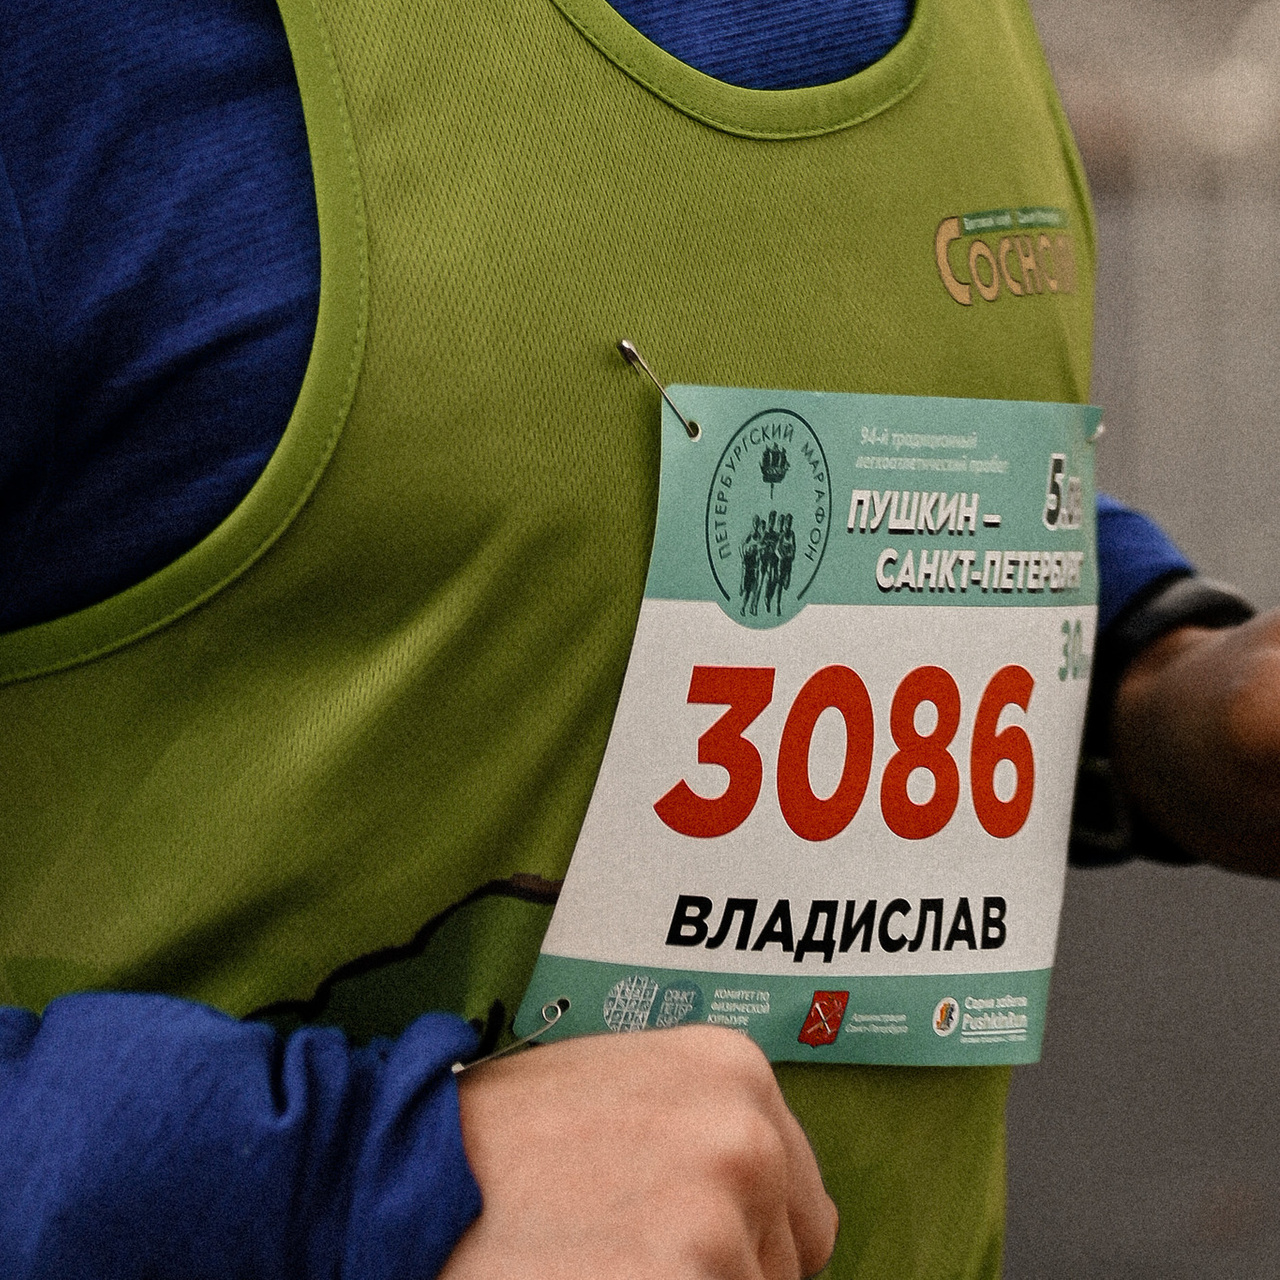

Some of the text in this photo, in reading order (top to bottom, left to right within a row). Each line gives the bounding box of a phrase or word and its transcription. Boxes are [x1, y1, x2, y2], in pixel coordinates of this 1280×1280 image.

[714, 422, 826, 562] ПЕТЕРБУРГСКИЙ МАРАФОН
[846, 489, 980, 536] ПУШКИН
[653, 664, 1035, 842] 3086
[665, 895, 1008, 964] ВЛАДИСЛАВ
